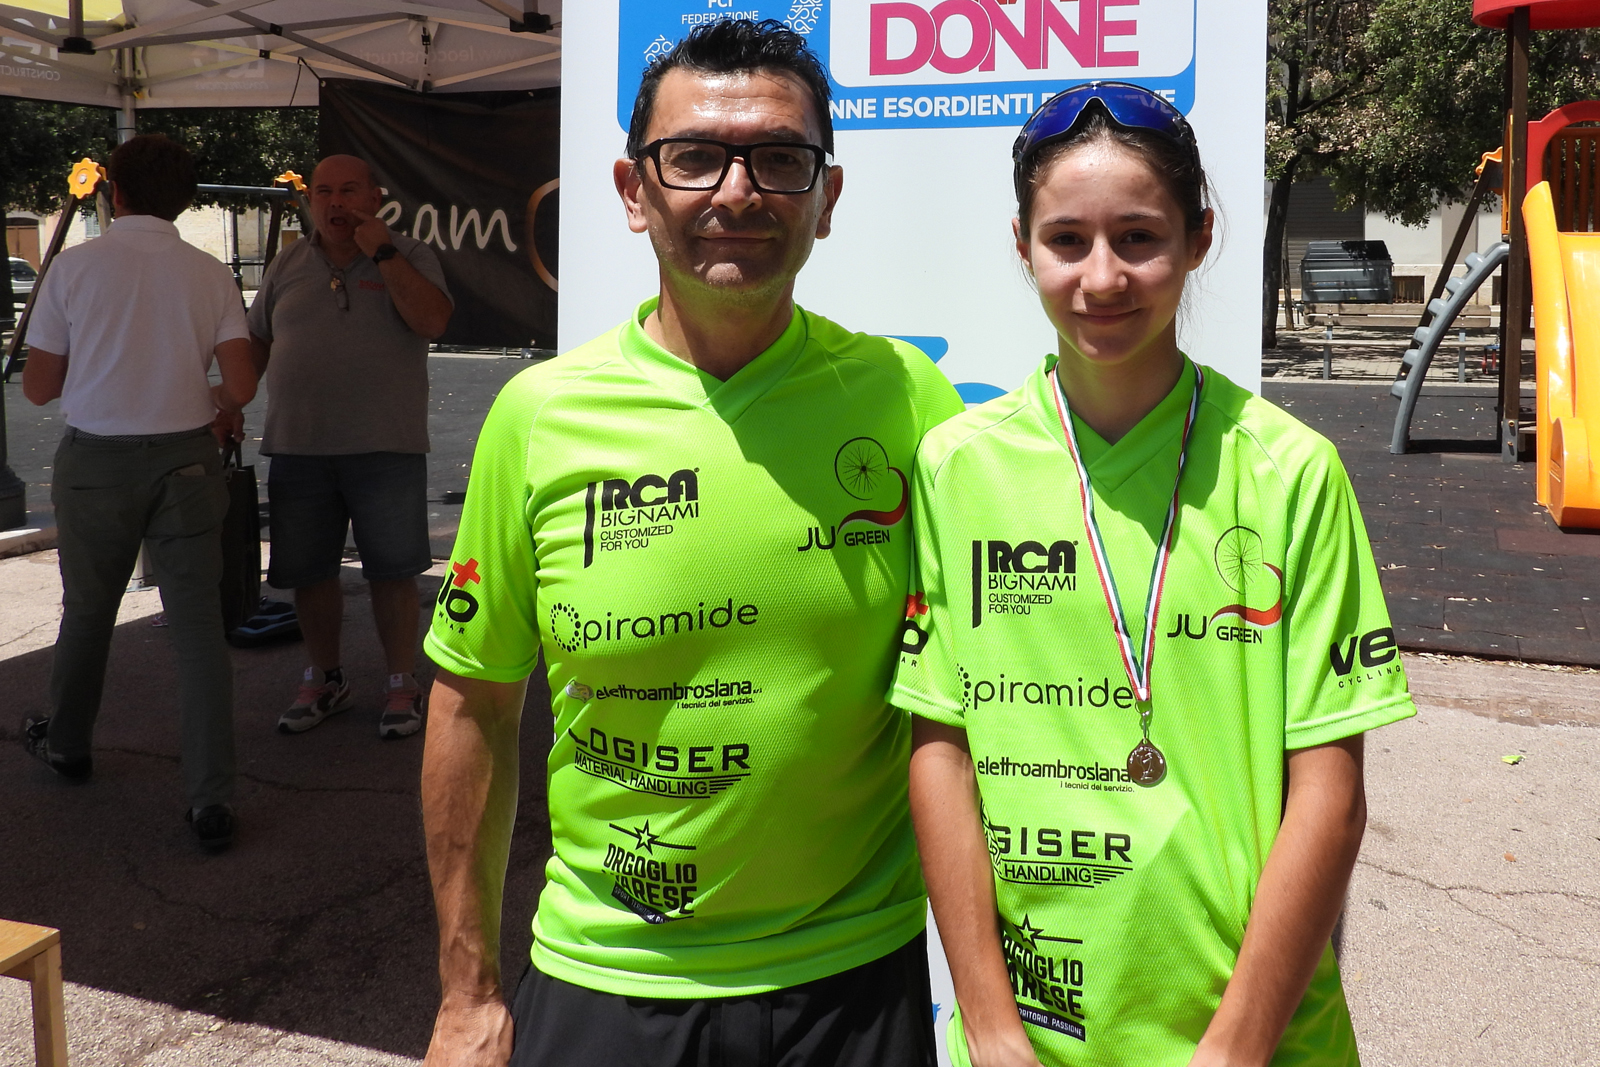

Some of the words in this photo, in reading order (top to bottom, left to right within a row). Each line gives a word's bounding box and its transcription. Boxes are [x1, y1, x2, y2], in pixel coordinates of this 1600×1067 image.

[869, 0, 1139, 76] DONNE
[829, 98, 877, 119] NNE
[883, 93, 1034, 118] ESORDIENTI
[375, 187, 518, 252] eam
[602, 469, 698, 511] RCA
[601, 502, 698, 527] BIGNAMI
[600, 525, 673, 541] CUSTOMIZED
[600, 541, 622, 552] FOR
[625, 538, 649, 550] YOU
[798, 526, 836, 551] JU
[844, 529, 890, 546] GREEN
[988, 540, 1076, 573] RCA
[988, 574, 1076, 591] BIGNAMI
[988, 593, 1053, 604] CUSTOMIZED
[988, 604, 1009, 614] FOR
[1010, 605, 1031, 615] YOU
[583, 598, 759, 649] piramide
[1167, 614, 1207, 640] JU
[1216, 626, 1263, 644] GREEN
[1338, 664, 1401, 689] CYCLING
[681, 700, 707, 709] tecnici
[708, 699, 720, 707] del
[974, 674, 1134, 711] piramide
[568, 727, 752, 773] LOGISER
[575, 751, 628, 784] MATERIAL
[631, 775, 708, 795] HANDLING
[1064, 781, 1089, 790] tecnici
[1090, 783, 1102, 791] del
[988, 822, 1133, 863] GISER
[603, 843, 697, 884] ORGOGLIO
[1004, 863, 1092, 883] HANDLING
[1008, 961, 1085, 1020] ARESE
[1051, 1018, 1083, 1037] PASSIONE
